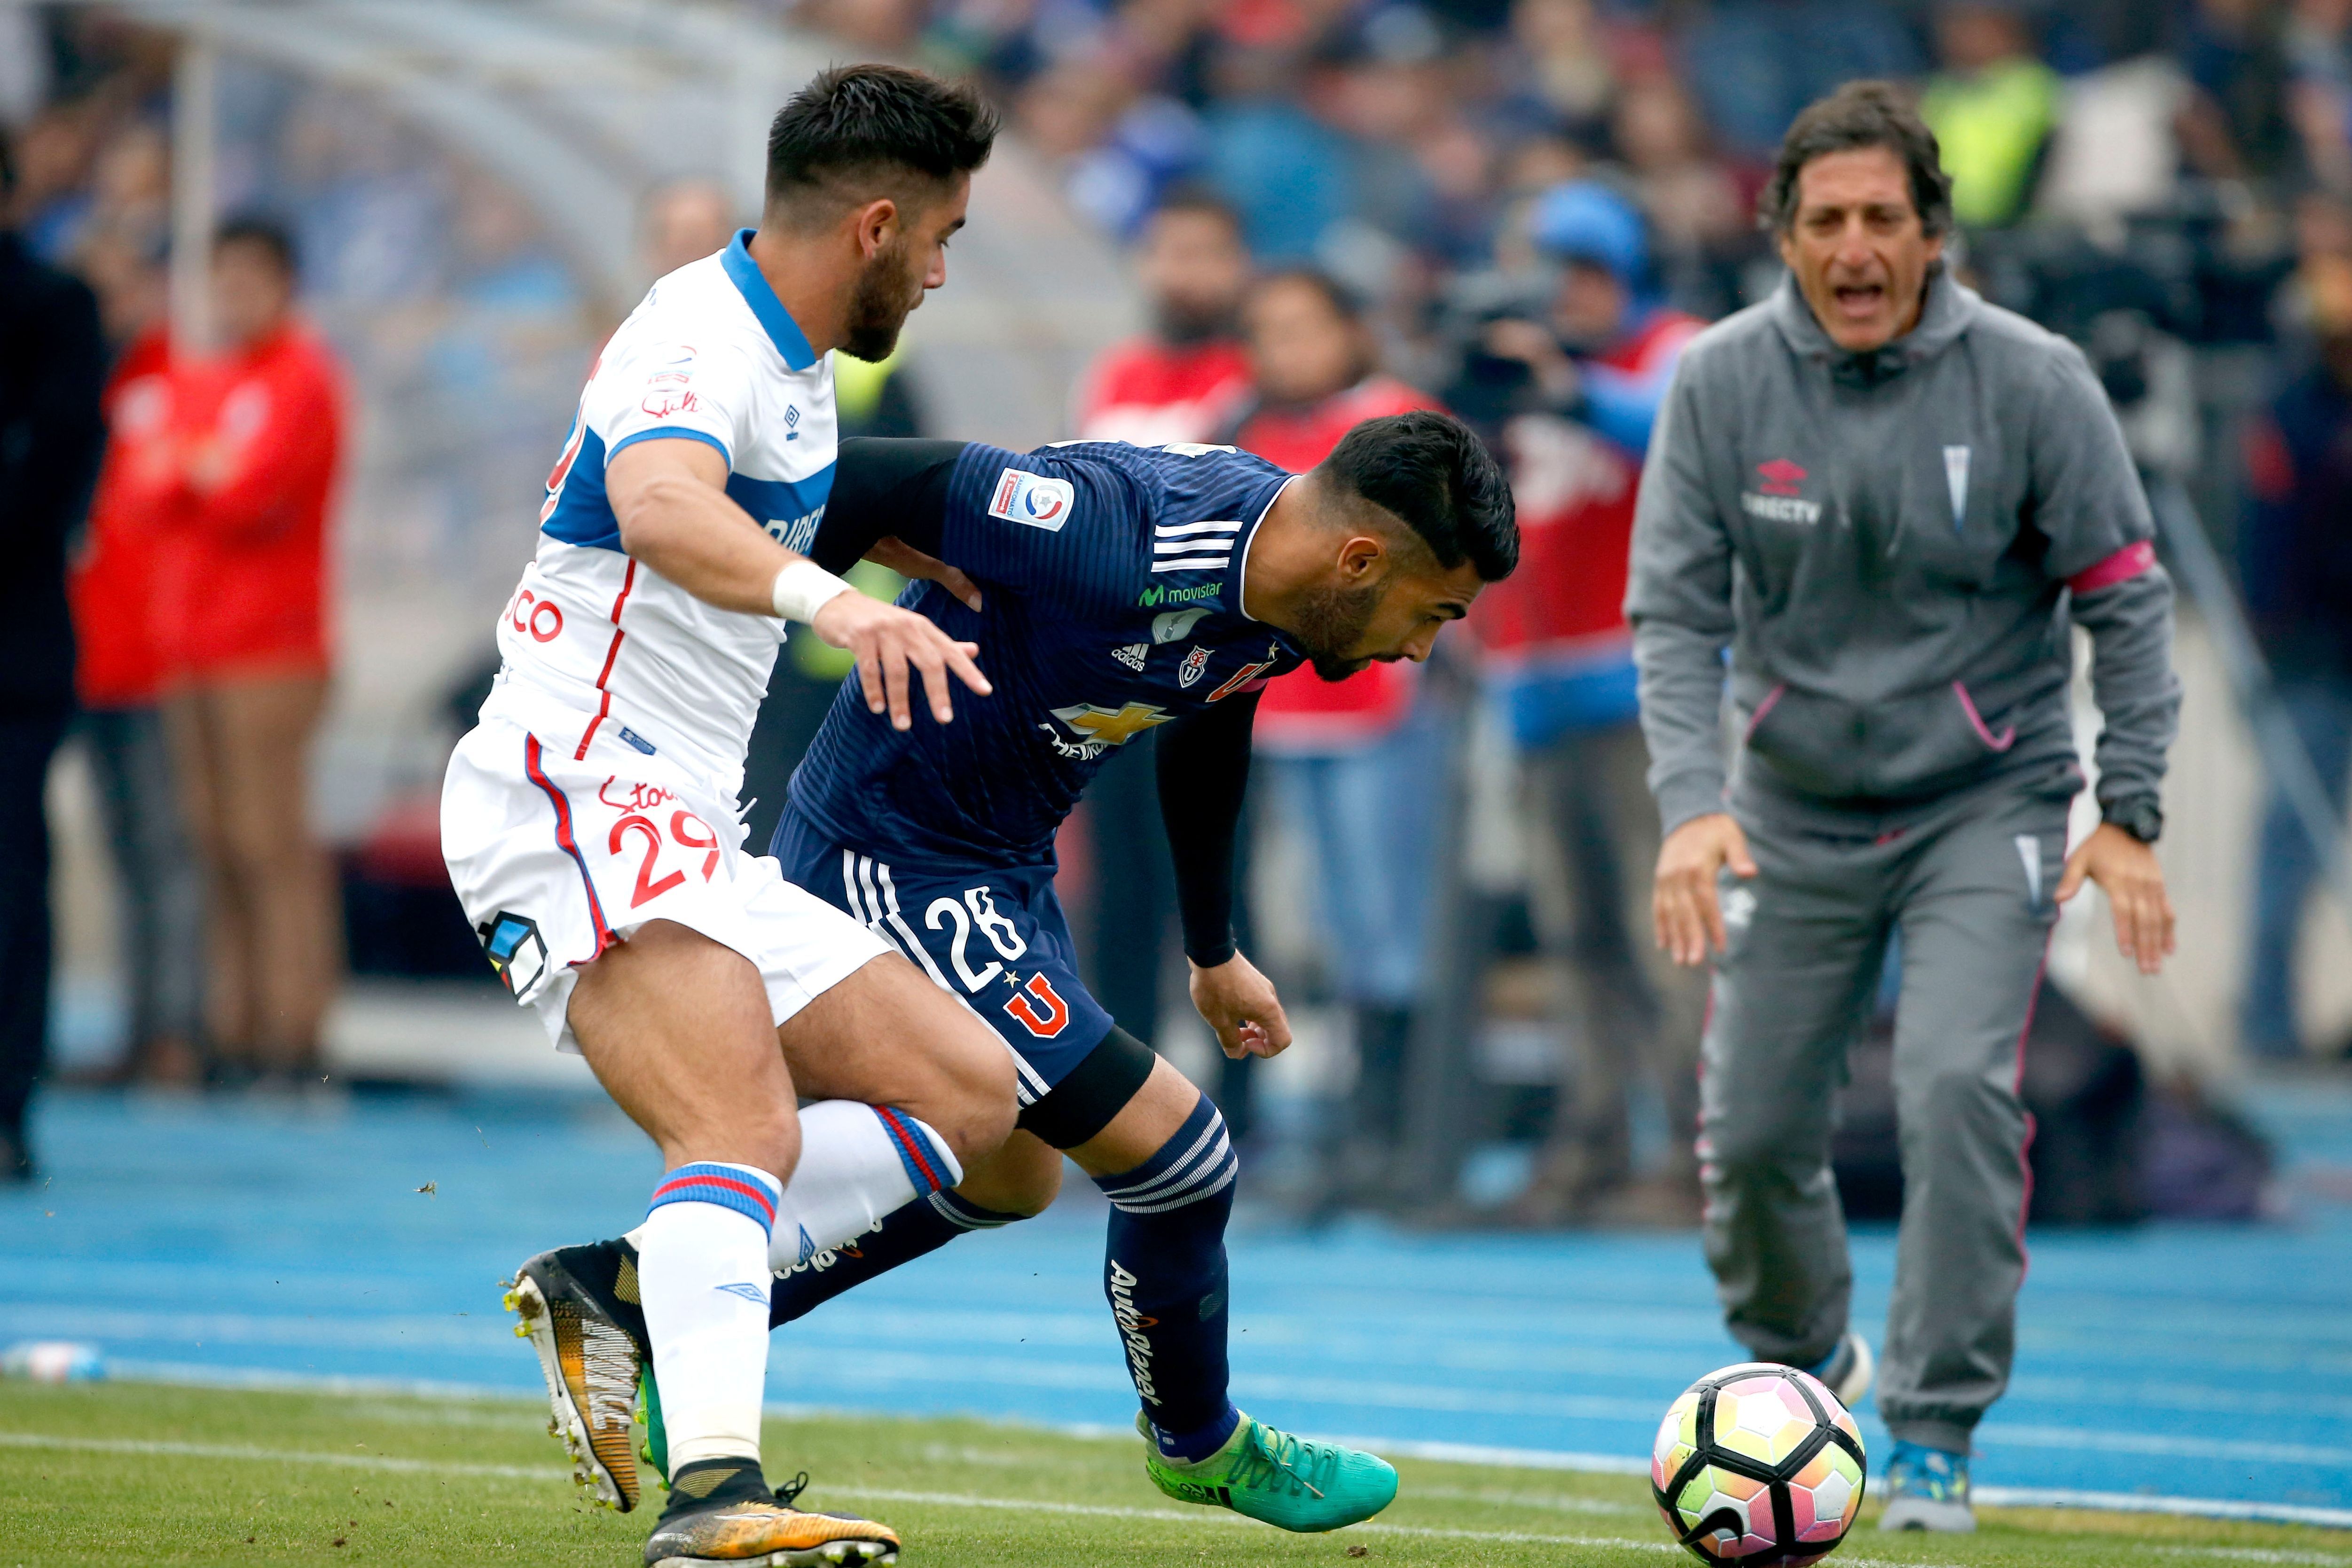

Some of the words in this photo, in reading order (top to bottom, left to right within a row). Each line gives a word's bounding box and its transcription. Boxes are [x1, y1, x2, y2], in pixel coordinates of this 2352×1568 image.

[1007, 475, 1025, 516] CAMPEONATO
[1169, 582, 1223, 603] movistar
[1111, 649, 1145, 672] adidas
[1038, 723, 1108, 760] CHEVRO
[608, 810, 720, 909] 29
[1003, 971, 1069, 1039] U
